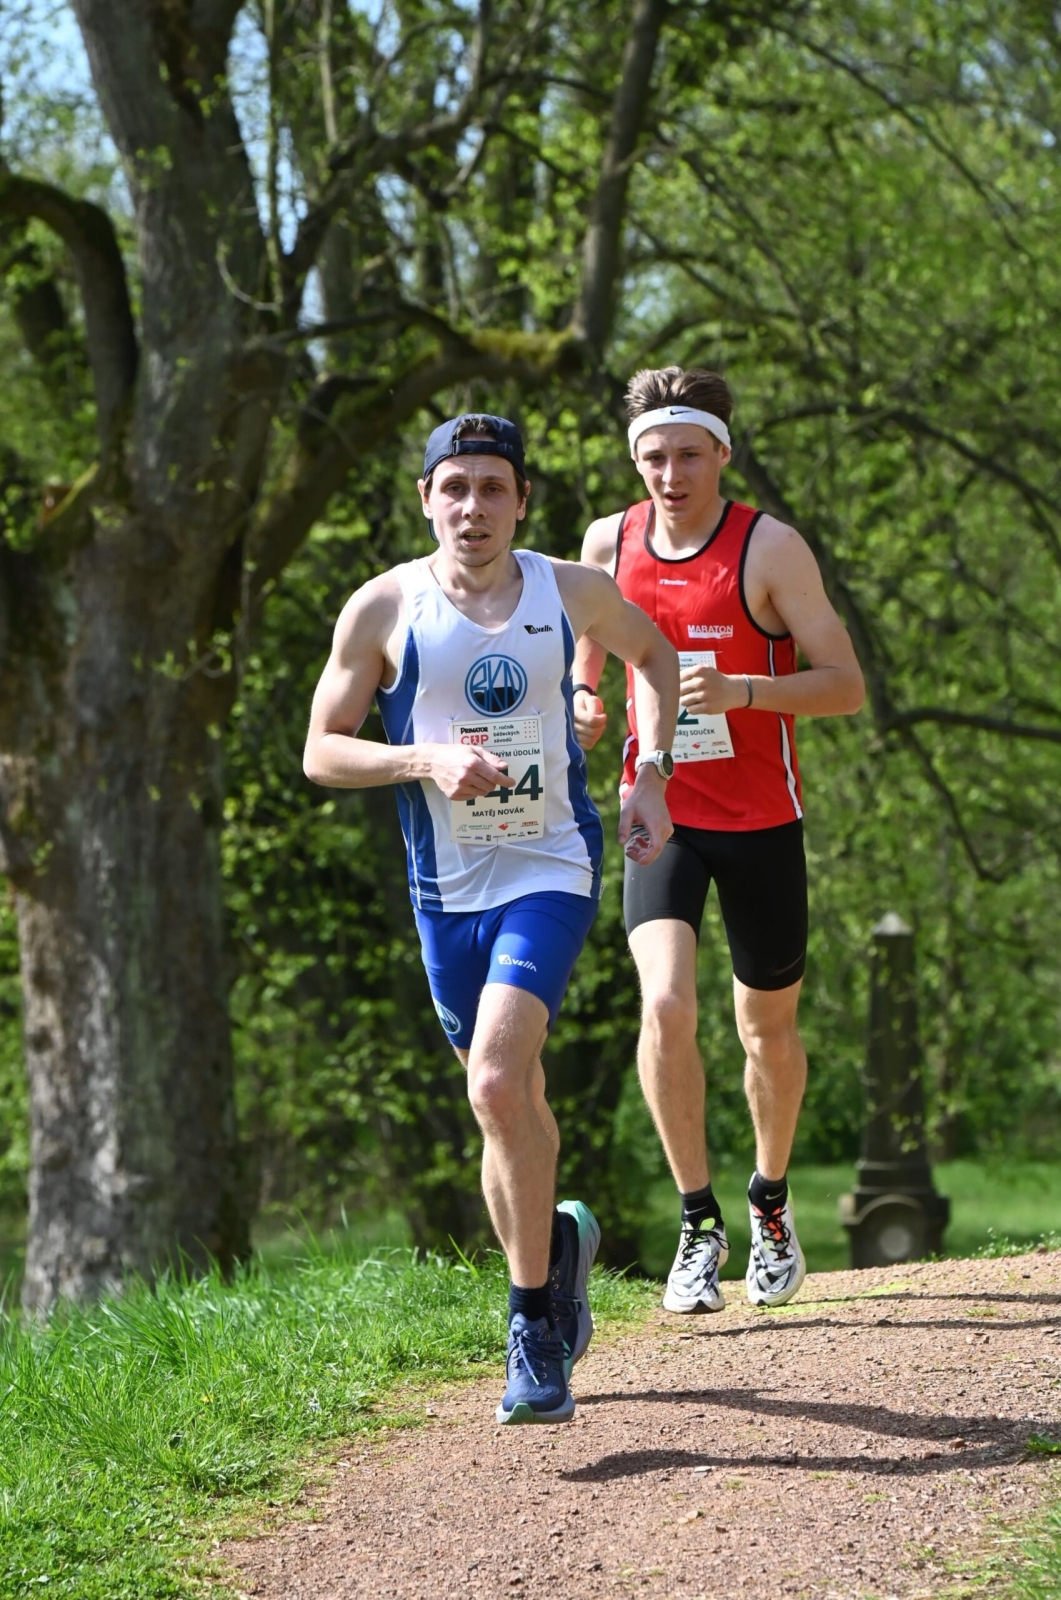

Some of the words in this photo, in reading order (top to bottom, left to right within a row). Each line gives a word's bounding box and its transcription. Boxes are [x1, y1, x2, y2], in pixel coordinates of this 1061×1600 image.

[688, 624, 733, 633] MARATON
[690, 728, 715, 736] SOUČEK
[460, 734, 489, 745] CUP
[513, 747, 540, 757] ÚDOLÍM
[466, 764, 543, 806] 44
[472, 809, 496, 817] MATĚJ
[497, 807, 525, 816] NOVÁK
